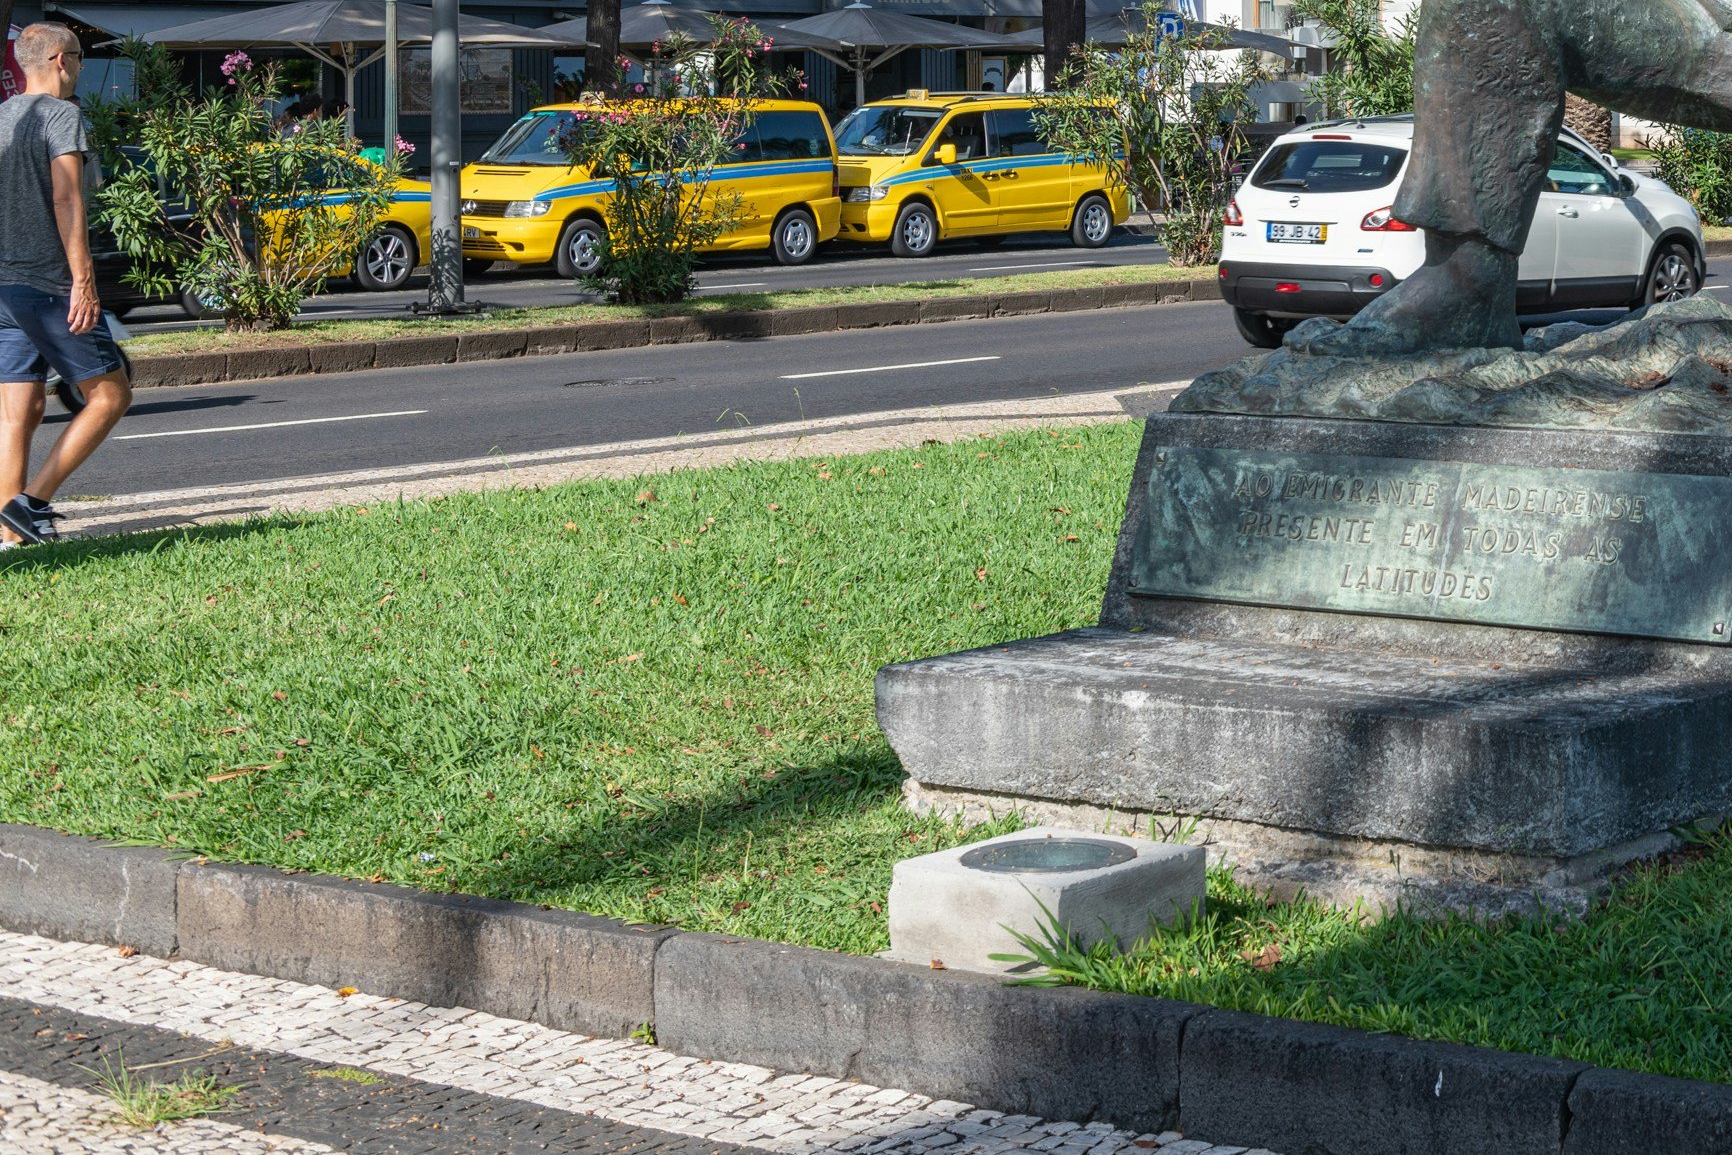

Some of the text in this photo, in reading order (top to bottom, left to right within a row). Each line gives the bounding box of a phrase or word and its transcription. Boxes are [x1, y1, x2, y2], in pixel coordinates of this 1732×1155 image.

[1235, 473, 1648, 522] AO EMIGRANTE MADEIRENSE
[1238, 510, 1622, 566] PRESENTE EM TODAS AS
[1340, 563, 1494, 601] LATITUDES
